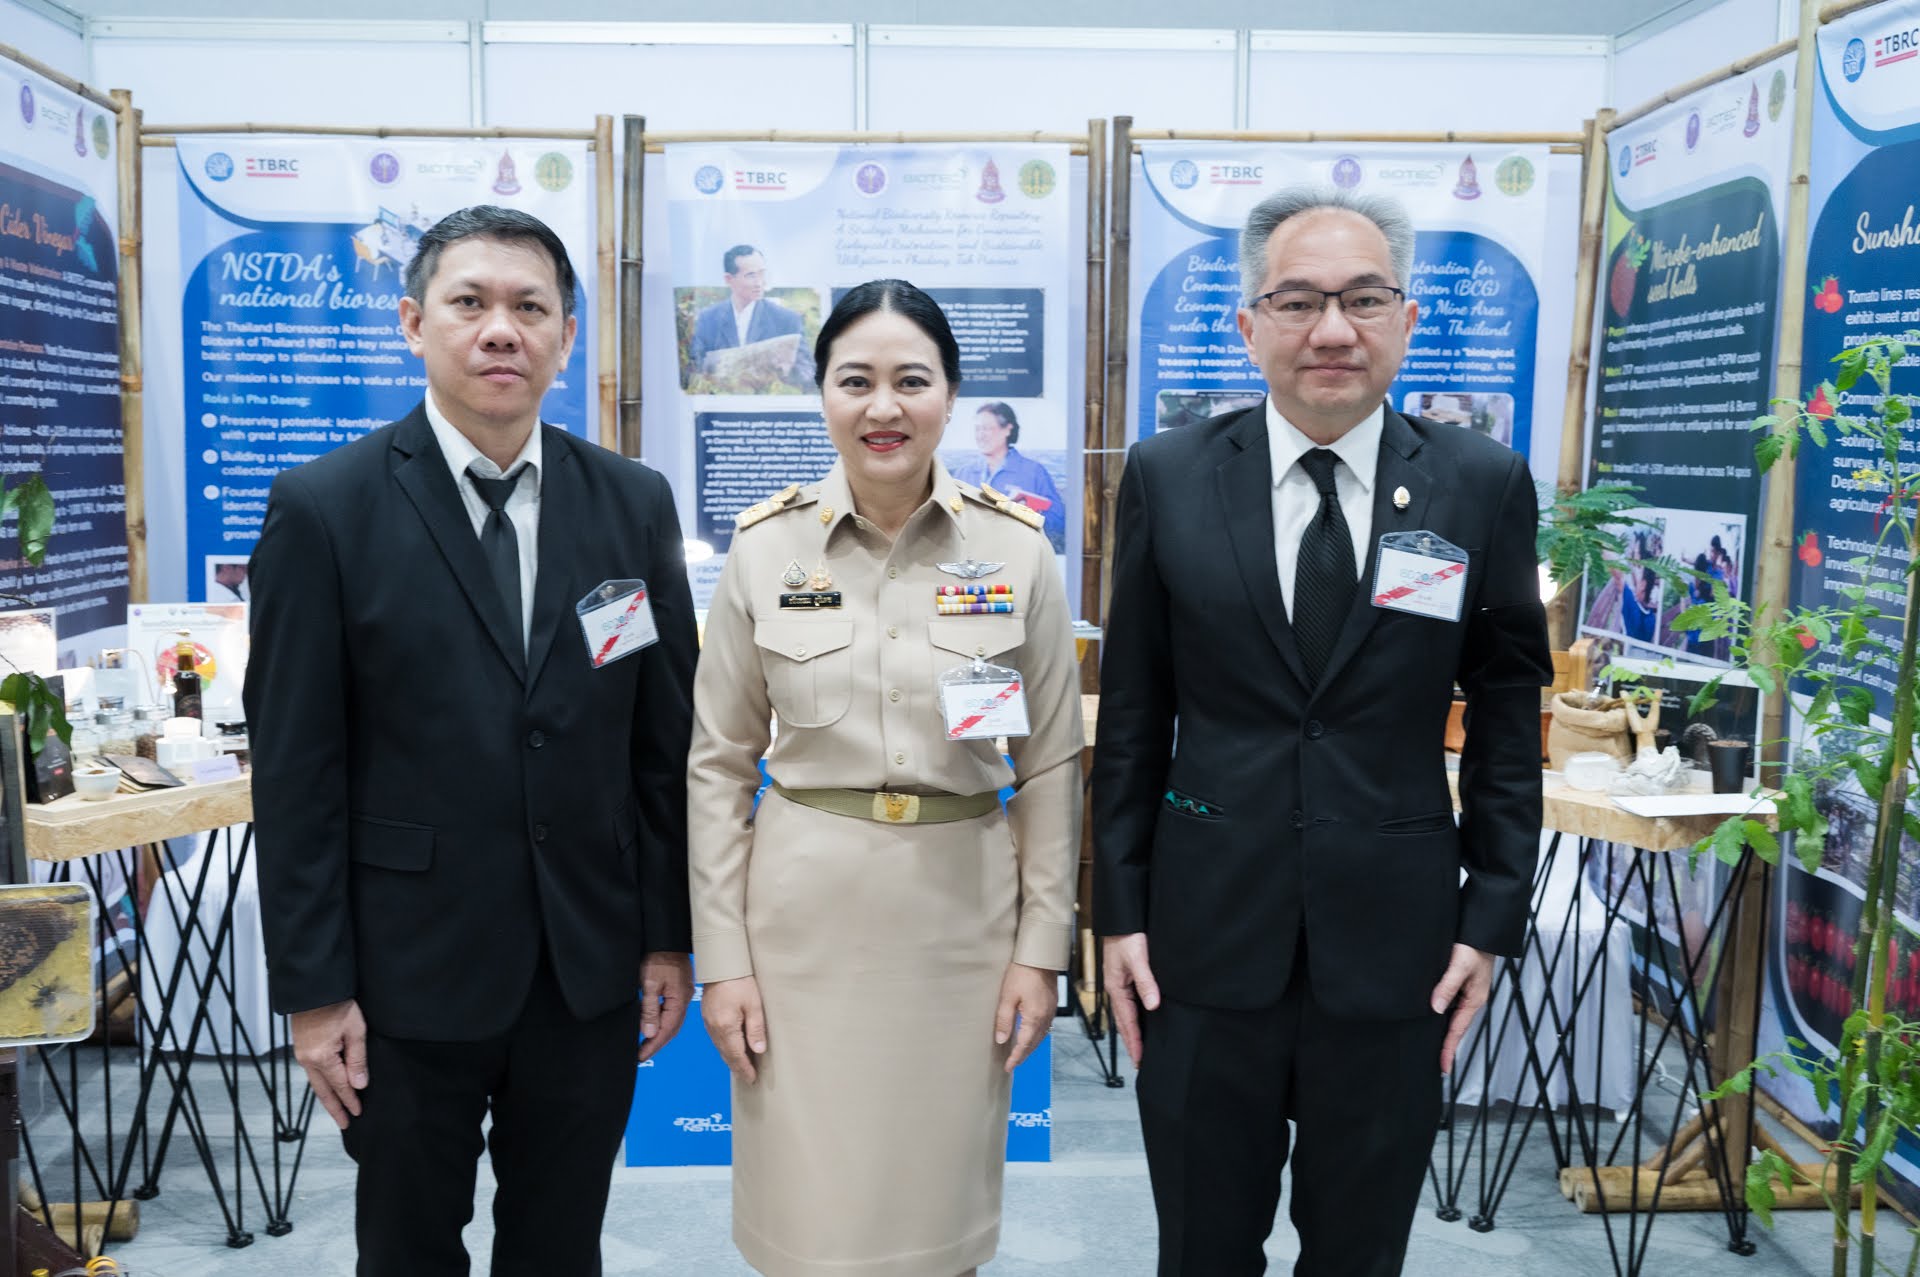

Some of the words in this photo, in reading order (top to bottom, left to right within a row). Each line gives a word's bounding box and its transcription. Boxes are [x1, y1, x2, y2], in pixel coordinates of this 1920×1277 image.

[1884, 28, 1920, 54] TBRC
[257, 158, 299, 171] TBRC
[1222, 166, 1263, 178] TBRC
[746, 171, 788, 184] TBRC
[221, 251, 342, 283] NSTDA's
[1471, 259, 1497, 280] for
[219, 282, 328, 309] national
[1411, 279, 1451, 296] Green
[1454, 279, 1500, 297] (BCG)
[1848, 289, 1880, 304] Tomato
[1881, 287, 1904, 302] lines
[1174, 296, 1232, 317] Economy
[1434, 299, 1469, 316] Mine
[1470, 300, 1506, 316] Area
[1875, 309, 1901, 324] sweet
[201, 321, 222, 333] The
[226, 321, 273, 334] Thailand
[275, 322, 341, 335] Bioresource
[342, 323, 394, 336] Research
[1168, 316, 1209, 333] under
[1211, 317, 1234, 333] the
[1447, 319, 1512, 336] Thailand
[246, 336, 258, 348] of
[260, 337, 306, 349] Thailand
[339, 341, 355, 350] are
[357, 340, 377, 351] key
[379, 340, 408, 350] natio
[1158, 344, 1176, 354] The
[1177, 344, 1207, 354] former
[1208, 345, 1226, 354] Pha
[201, 351, 232, 362] basic
[234, 352, 276, 364] storage
[277, 352, 290, 362] to
[292, 353, 343, 364] stimulate
[345, 353, 404, 365] innovation.
[1158, 358, 1200, 367] treasure
[1410, 361, 1452, 371] economy
[1496, 361, 1516, 371] this
[201, 371, 222, 383] Our
[225, 372, 268, 384] mission
[269, 372, 279, 384] is
[281, 373, 293, 384] to
[295, 374, 341, 385] increase
[342, 374, 361, 385] the
[363, 375, 393, 387] value
[394, 375, 407, 387] of
[1400, 372, 1465, 384] community-led
[1466, 374, 1516, 384] innovation.
[202, 393, 229, 404] Role
[232, 393, 244, 405] in
[246, 393, 268, 405] Pha
[220, 415, 279, 428] Preserving
[281, 416, 333, 429] potential:
[221, 430, 245, 441] with
[247, 431, 277, 443] great
[278, 431, 327, 444] potential
[330, 432, 344, 443] for
[221, 450, 266, 464] Building
[268, 454, 275, 463] a
